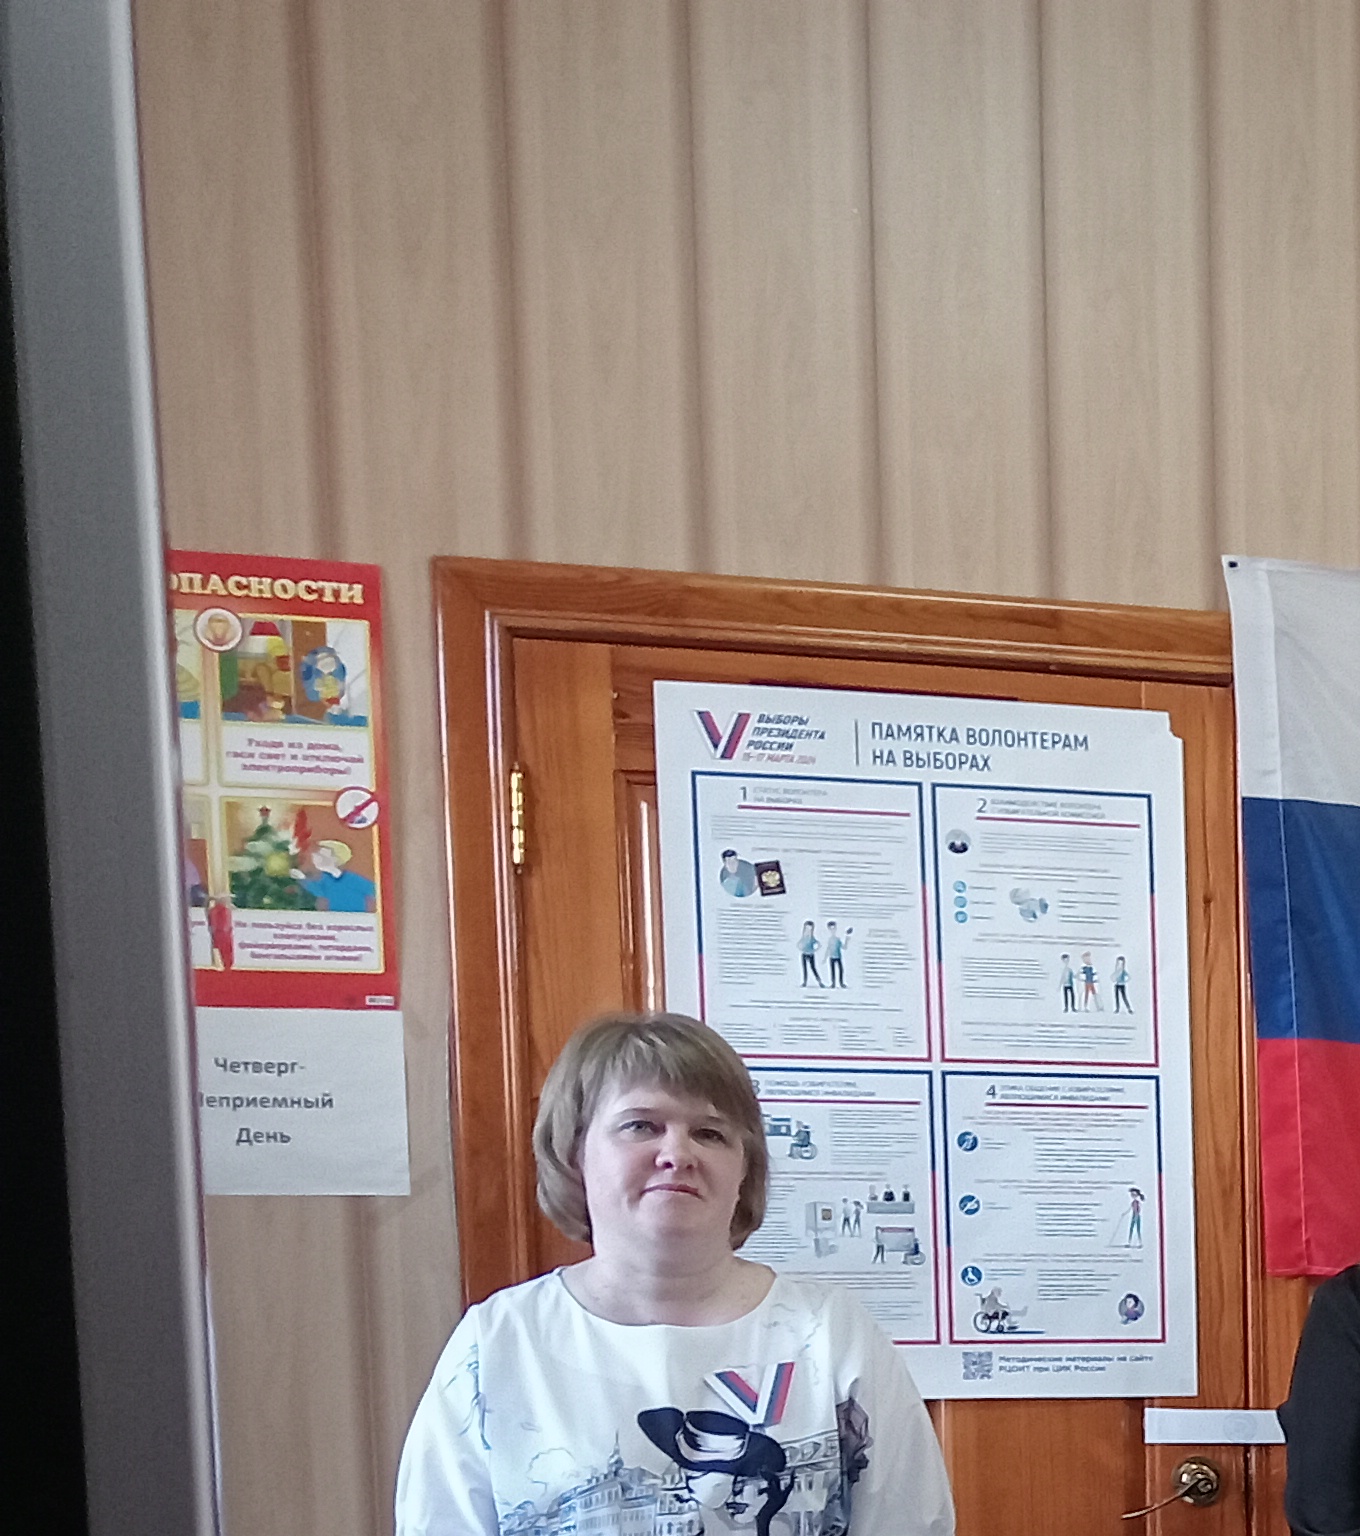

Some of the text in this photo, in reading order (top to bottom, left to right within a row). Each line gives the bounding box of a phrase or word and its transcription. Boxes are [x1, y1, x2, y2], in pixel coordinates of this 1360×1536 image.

[756, 713, 810, 726] ВЫБОРЫ
[752, 726, 826, 740] ПРЕЗИДЕНТА
[871, 721, 1090, 750] ПАМЯТКА ВОЛОНТЕРАМ
[747, 740, 795, 751] РОССИИ
[872, 748, 992, 772] НА ВЫБОРАХ
[739, 786, 747, 801] 1
[976, 797, 988, 813] 2
[213, 1056, 306, 1078] Четверг-
[986, 1084, 997, 1100] 4
[235, 1127, 292, 1147] День
